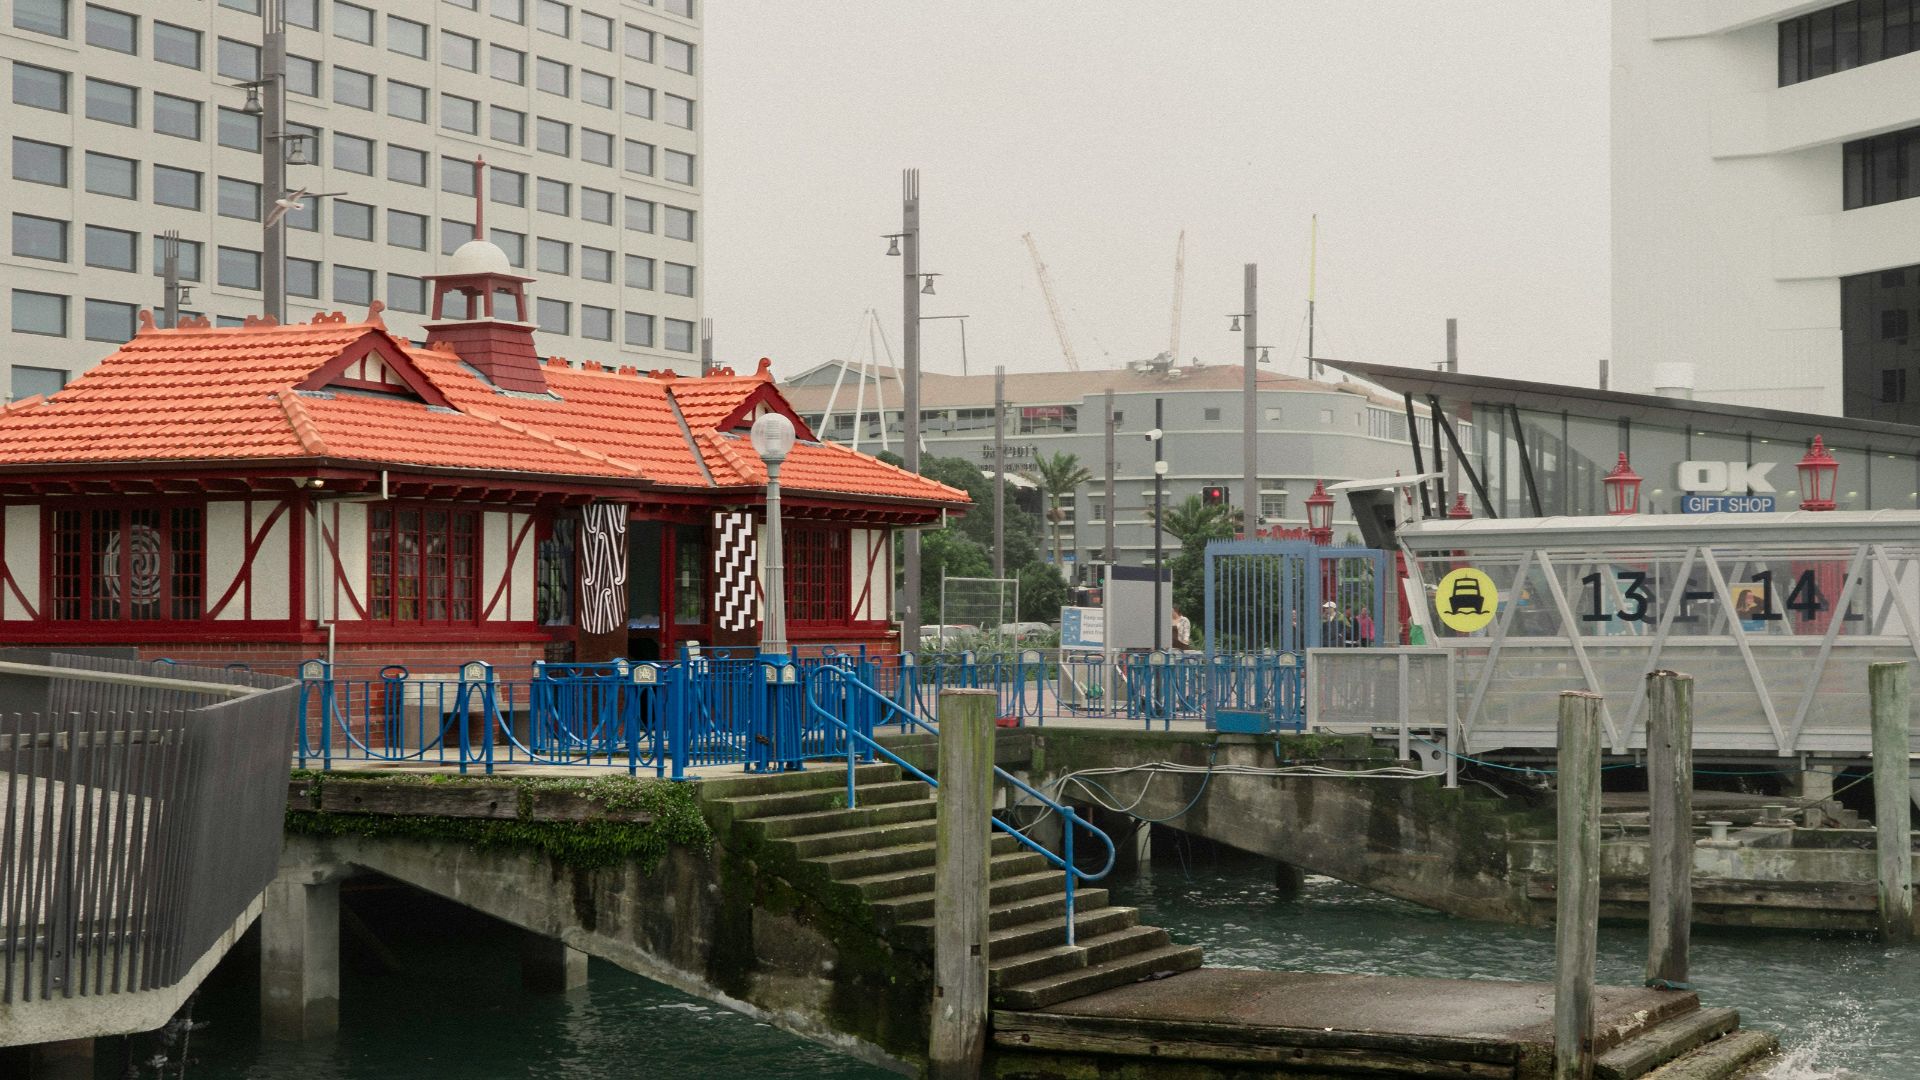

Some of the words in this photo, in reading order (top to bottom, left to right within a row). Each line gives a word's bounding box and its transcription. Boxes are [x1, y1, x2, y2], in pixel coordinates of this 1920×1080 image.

[1679, 461, 1777, 492] OK
[1689, 497, 1724, 512] GIFT
[1728, 498, 1772, 512] SHOP
[1582, 572, 1647, 621] 13
[1751, 570, 1822, 621] 14
